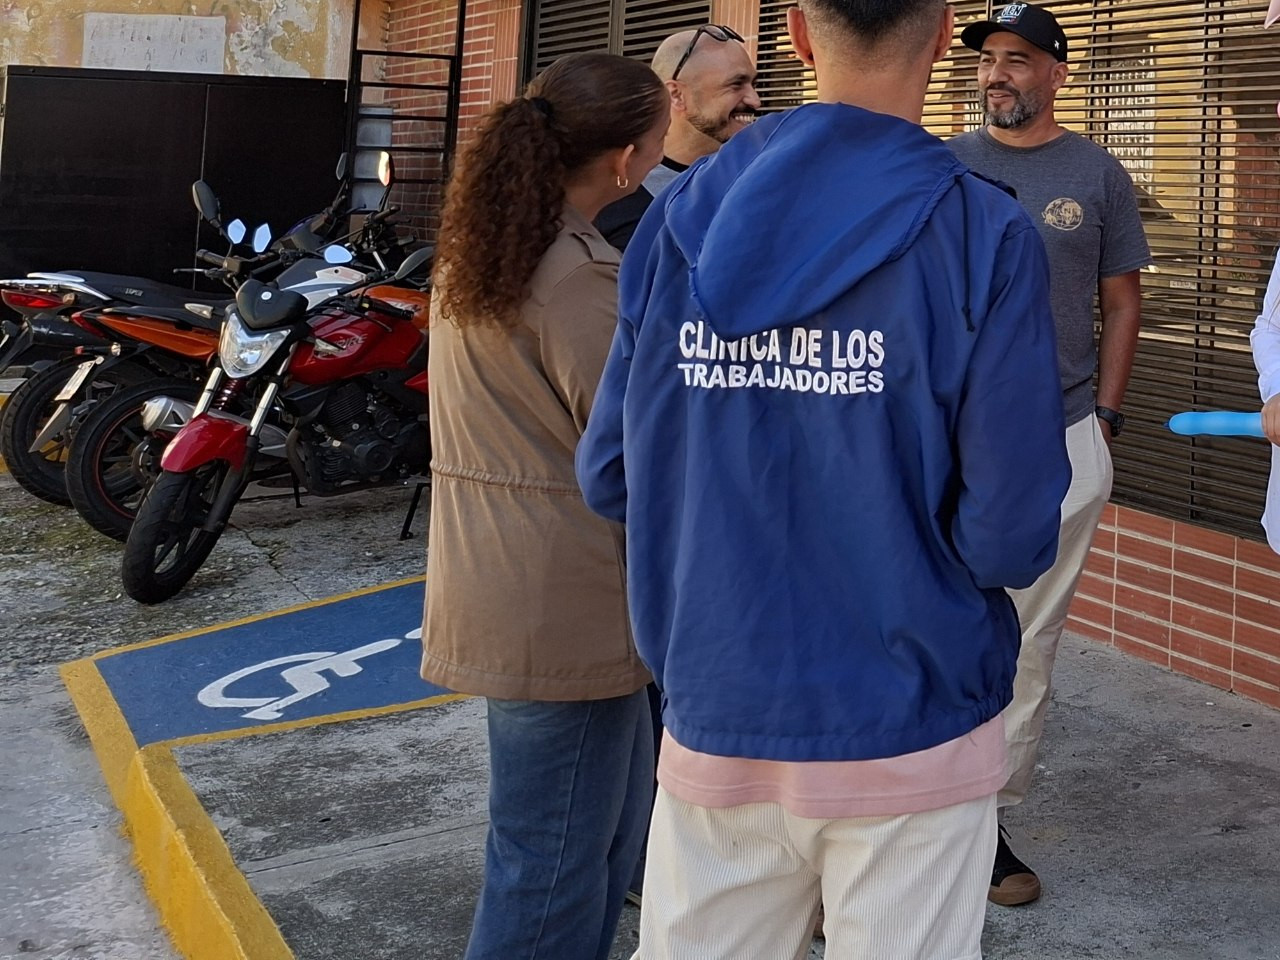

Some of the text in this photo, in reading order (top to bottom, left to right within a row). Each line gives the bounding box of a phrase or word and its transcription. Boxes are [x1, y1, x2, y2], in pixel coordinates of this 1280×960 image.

[789, 327, 823, 368] DE
[832, 329, 885, 369] LOS
[677, 363, 885, 396] TRABAJADORES
